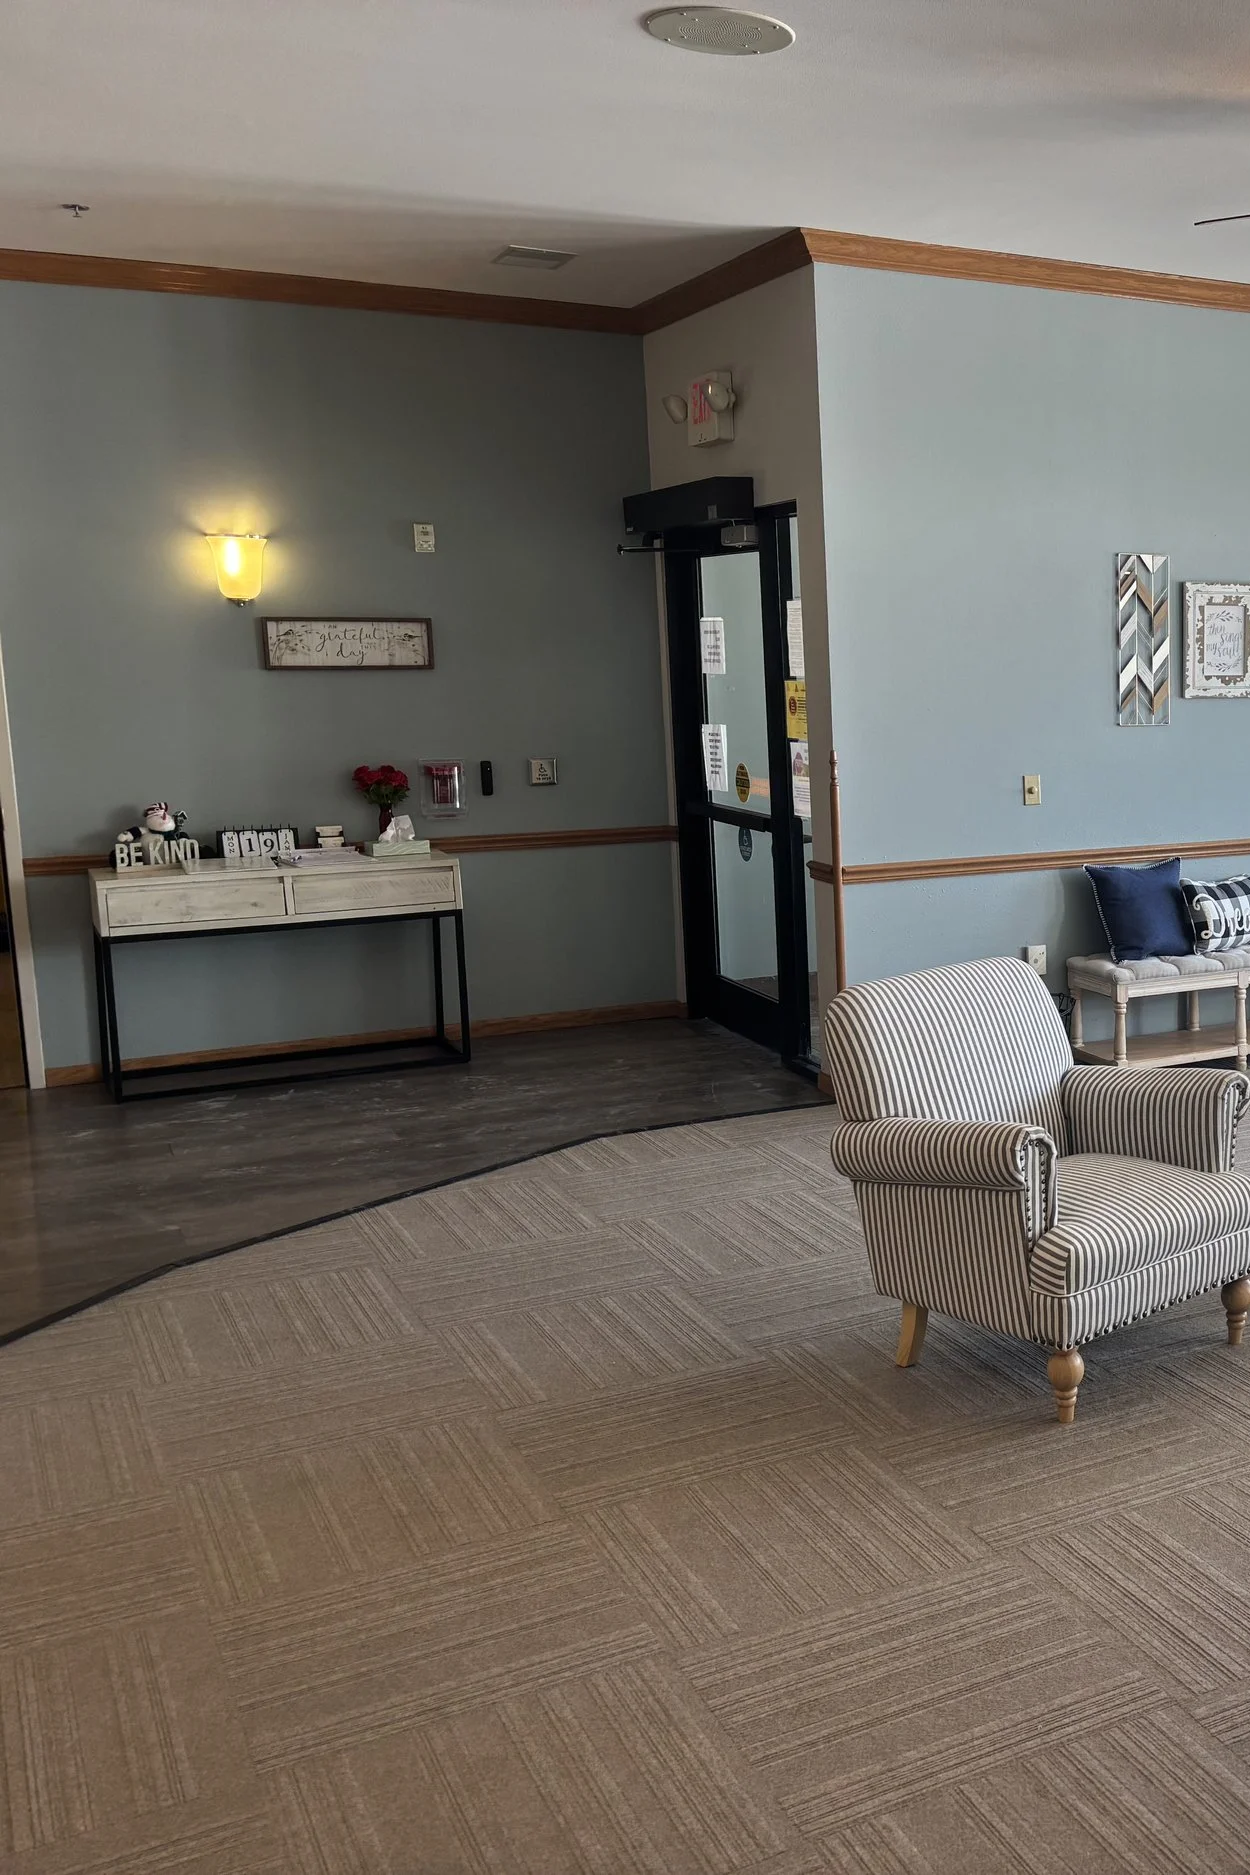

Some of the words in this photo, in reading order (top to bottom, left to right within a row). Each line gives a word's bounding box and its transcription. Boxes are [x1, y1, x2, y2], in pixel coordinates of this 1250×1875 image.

[115, 842, 143, 867] BE
[149, 838, 200, 867] KIND
[226, 836, 235, 854] MON
